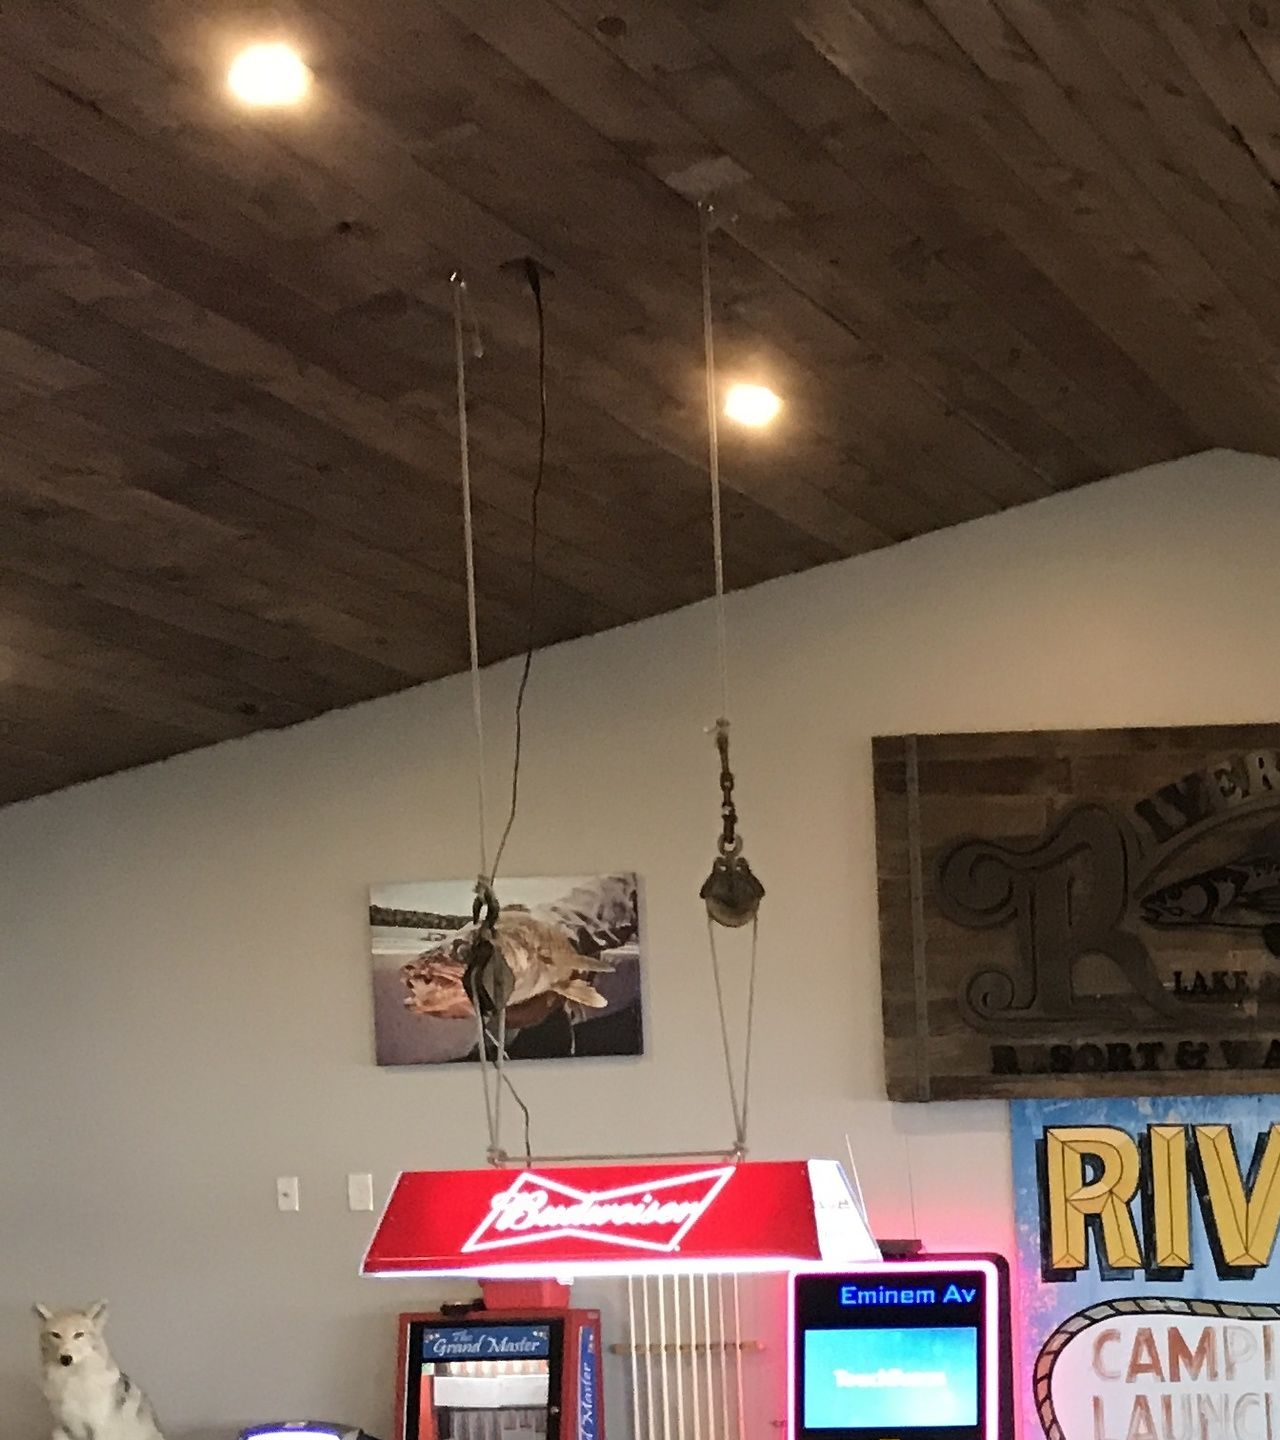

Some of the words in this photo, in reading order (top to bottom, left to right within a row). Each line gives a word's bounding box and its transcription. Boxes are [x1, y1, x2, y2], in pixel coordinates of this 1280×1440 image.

[1172, 969, 1250, 995] LAKE
[490, 1190, 706, 1231] Budweiser
[840, 1285, 936, 1306] Eminem
[942, 1284, 977, 1304] Av
[433, 1334, 486, 1357] Grand
[487, 1336, 540, 1353] Master
[581, 1361, 593, 1425] Master
